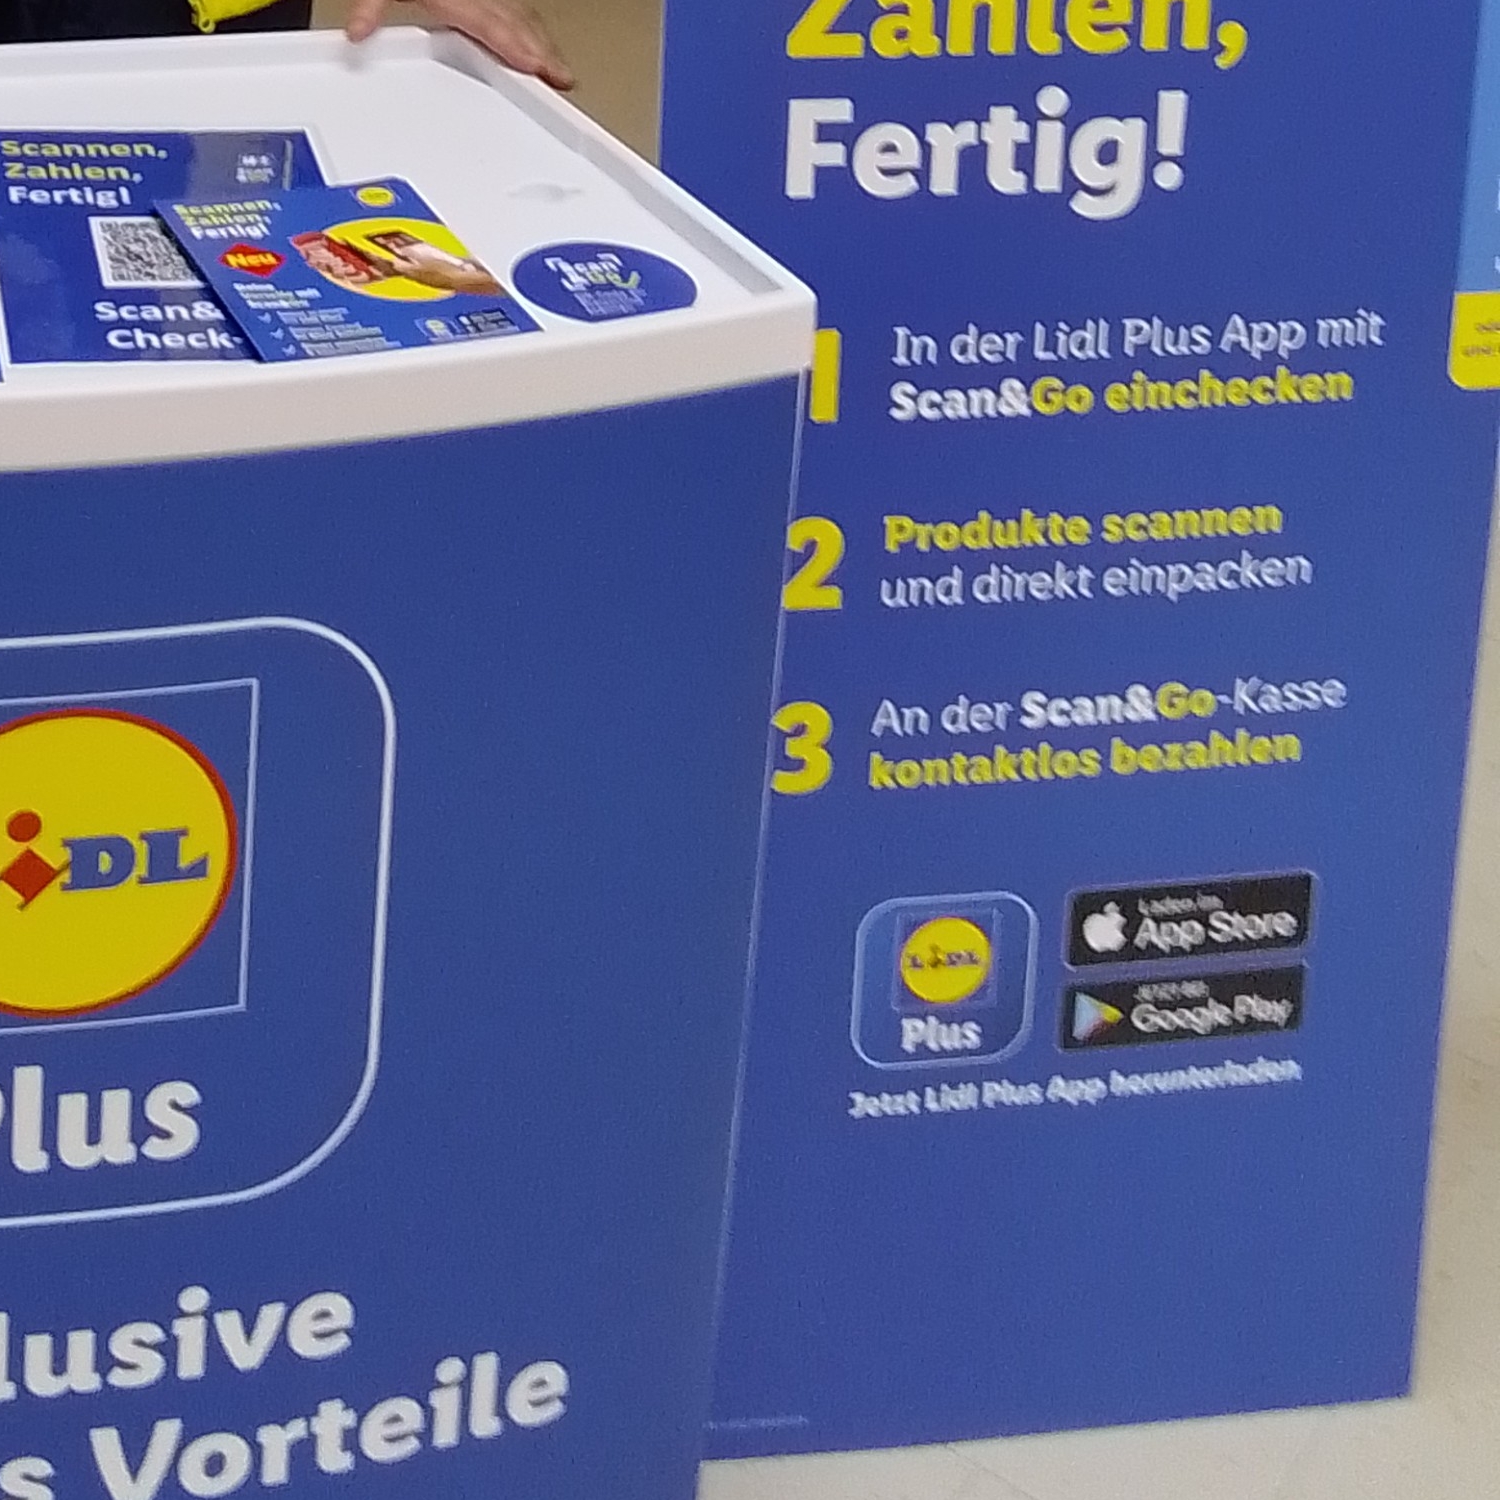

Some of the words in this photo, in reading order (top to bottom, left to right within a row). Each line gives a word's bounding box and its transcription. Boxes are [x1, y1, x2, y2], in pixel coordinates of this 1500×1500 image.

[0, 140, 168, 159] Scannen,
[4, 161, 143, 184] Zahlen,
[784, 84, 1189, 220] Fertig!
[8, 186, 131, 208] Fertig!
[226, 253, 278, 268] Neu
[892, 326, 938, 366] In
[950, 323, 1024, 364] der
[1034, 319, 1109, 362] Lidl
[1122, 315, 1212, 358] Plus
[1219, 314, 1306, 360] App
[1316, 307, 1386, 348] mit
[809, 327, 841, 423] 1
[889, 377, 1094, 422] Scan&Go
[1104, 365, 1354, 413] einchecken
[883, 509, 1091, 553] Produkte
[1101, 503, 1283, 545] scannen
[781, 516, 846, 612] 2
[879, 566, 963, 609] und
[971, 561, 1094, 605] direkt
[1102, 550, 1313, 602] einpacken
[869, 699, 933, 739] An
[940, 696, 1010, 736] der
[1018, 675, 1348, 729] Scan&Go-Kasse
[769, 701, 834, 795] 3
[868, 740, 1101, 790] kontaktlos
[1109, 729, 1302, 776] bezahlen
[1133, 917, 1206, 953] App
[1207, 911, 1298, 943] Store
[901, 1015, 983, 1054] Plus
[1130, 997, 1234, 1035] Google
[1232, 993, 1294, 1027] Play
[848, 1089, 922, 1119] Jetzt
[924, 1083, 980, 1113] Lidl
[982, 1079, 1045, 1109] Plus
[1046, 1074, 1109, 1106] App
[89, 1351, 570, 1500] Vorteile
